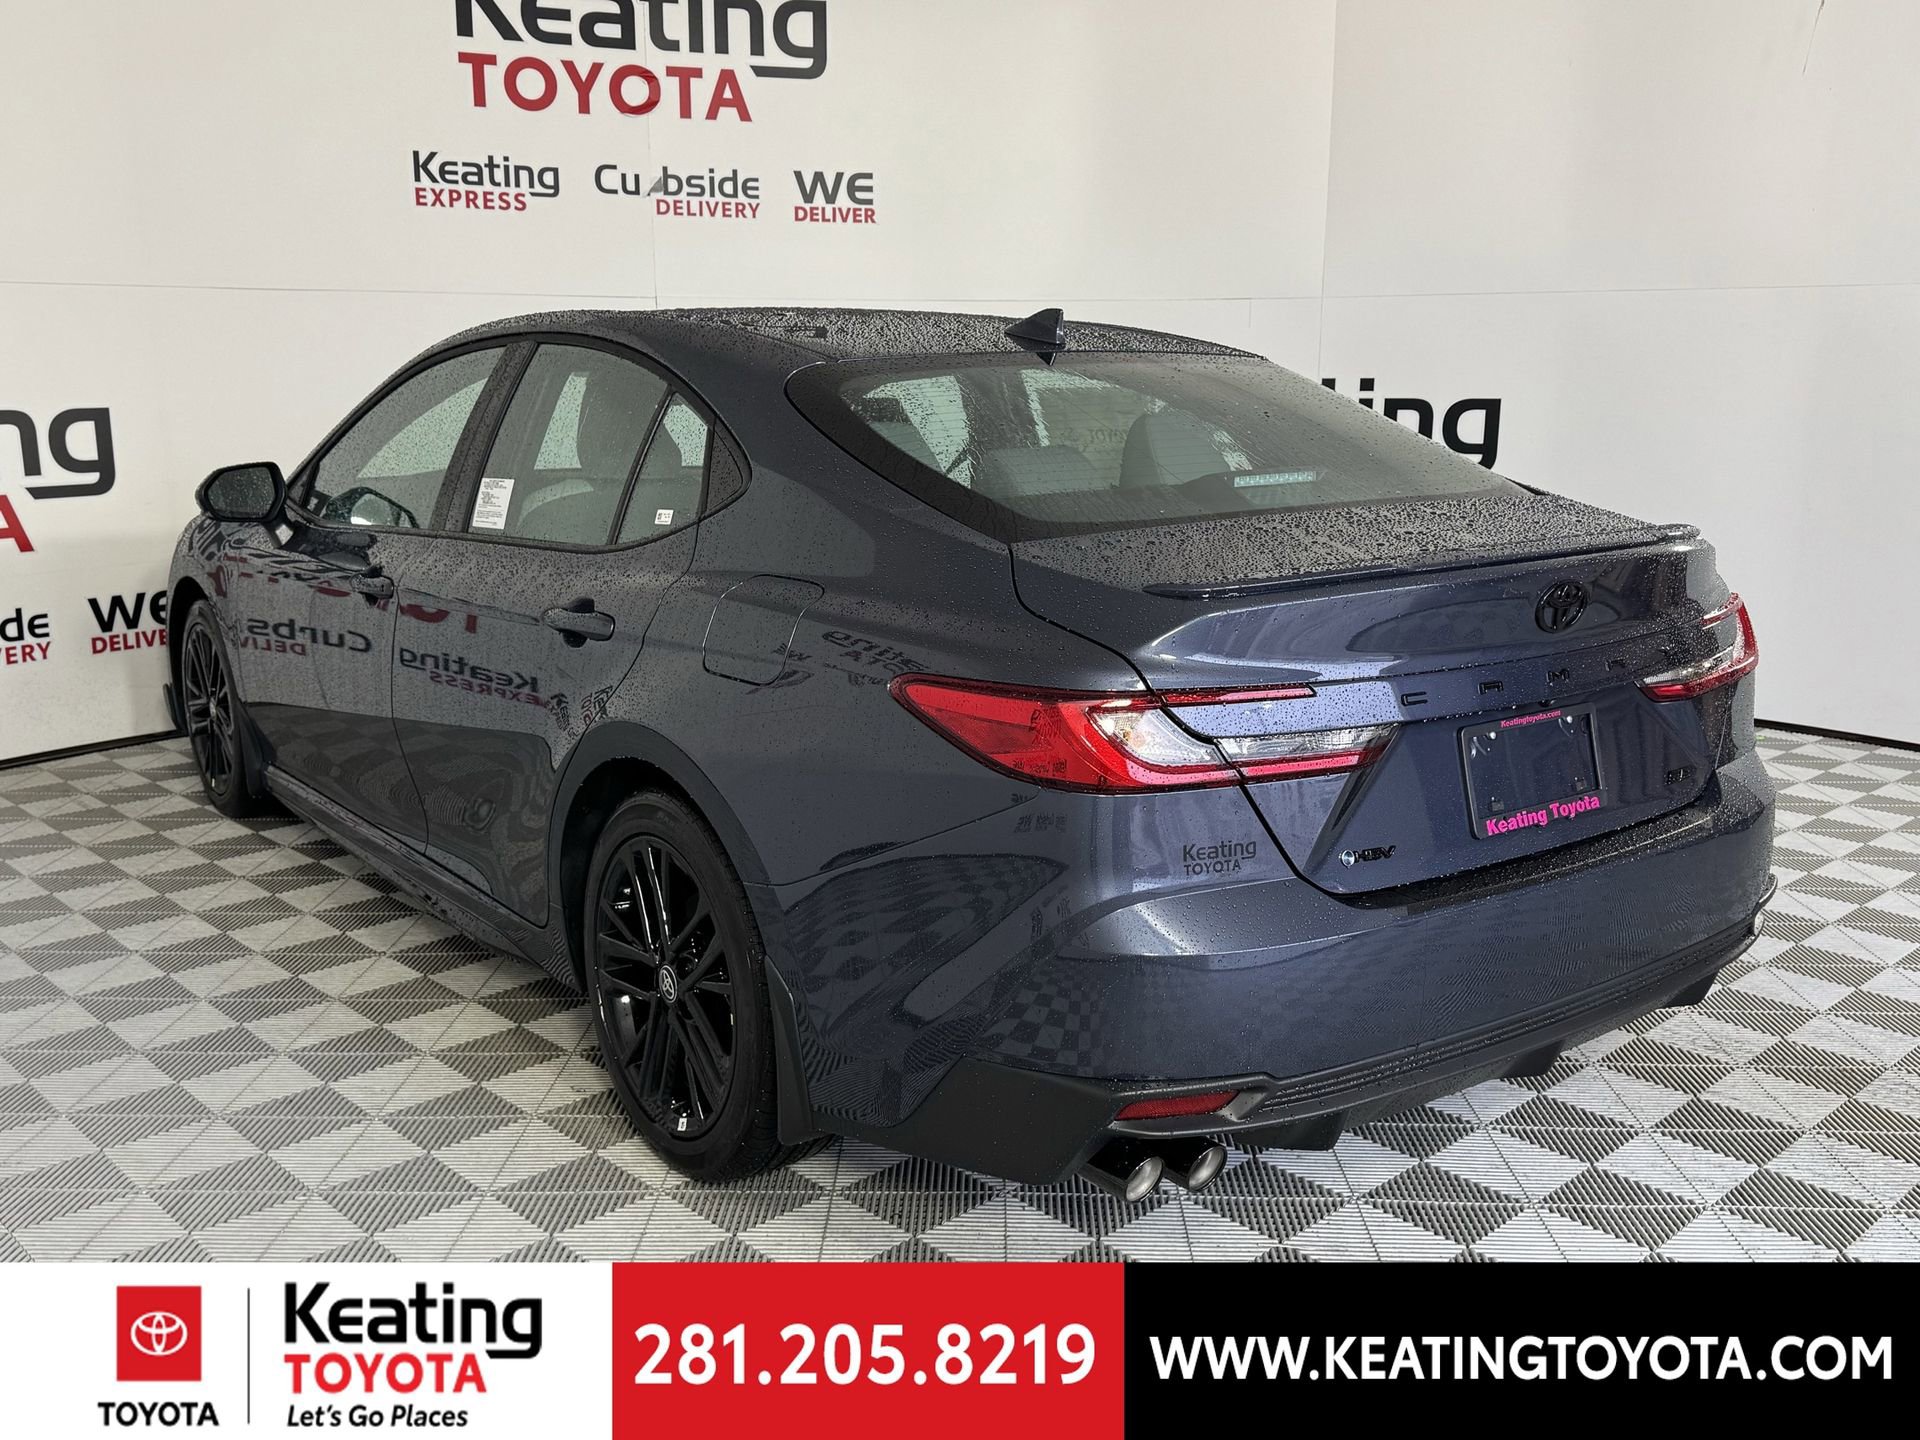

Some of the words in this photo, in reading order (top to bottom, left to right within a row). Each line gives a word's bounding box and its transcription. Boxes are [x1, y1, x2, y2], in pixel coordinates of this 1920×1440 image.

[457, 51, 753, 123] TOYOTA
[412, 150, 560, 198] Keating
[594, 164, 760, 200] Cubside
[415, 187, 528, 212] EXPRESS
[655, 199, 760, 219] DELIVERY
[793, 206, 876, 224] DELIVER
[92, 629, 168, 655] DELIVE
[1486, 808, 1549, 836] Keating
[1549, 795, 1601, 821] Toyota
[1182, 839, 1257, 862] Keating
[1183, 859, 1242, 876] TOYOTA
